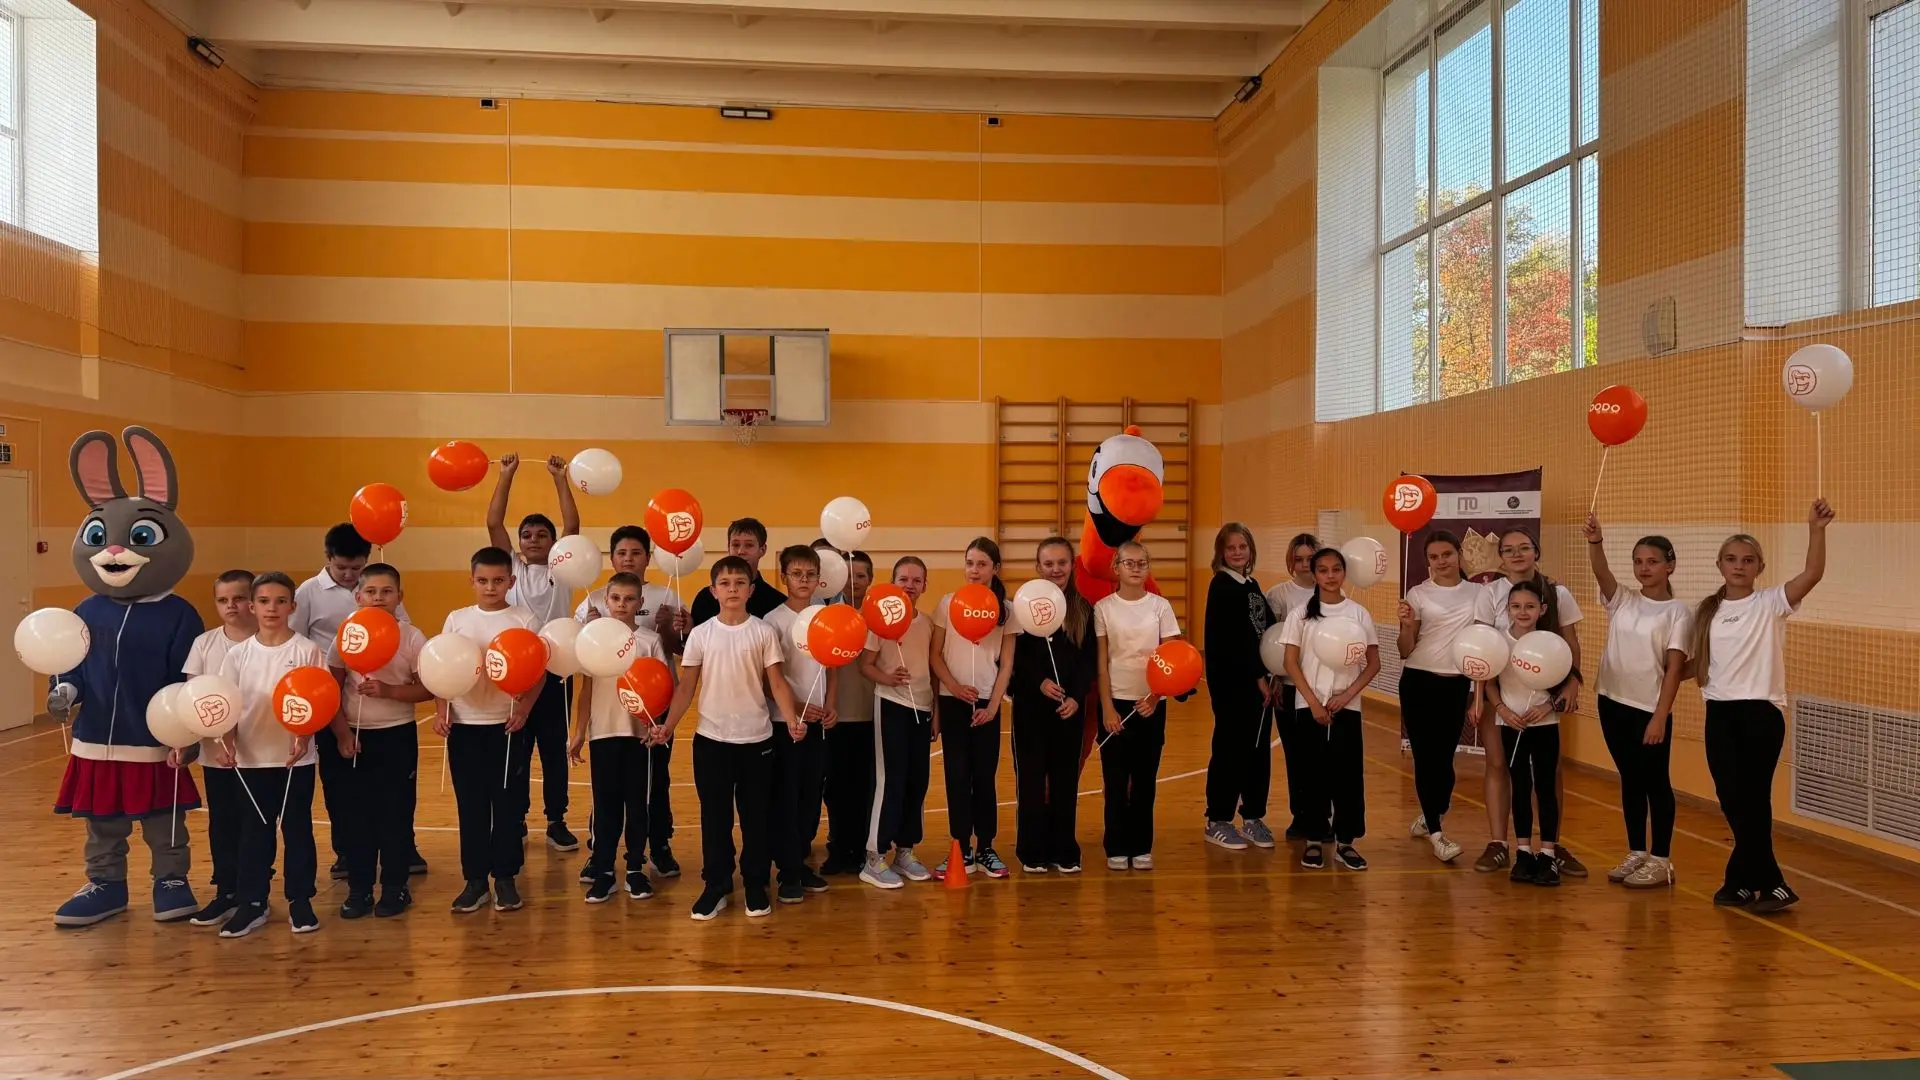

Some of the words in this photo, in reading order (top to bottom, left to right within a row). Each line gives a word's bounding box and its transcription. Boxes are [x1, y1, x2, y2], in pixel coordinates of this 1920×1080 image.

[856, 519, 872, 530] DO
[549, 551, 572, 570] DODO
[963, 608, 996, 619] DODO
[797, 642, 809, 651] DO
[832, 647, 863, 658] DOD
[1511, 655, 1541, 673] DODO
